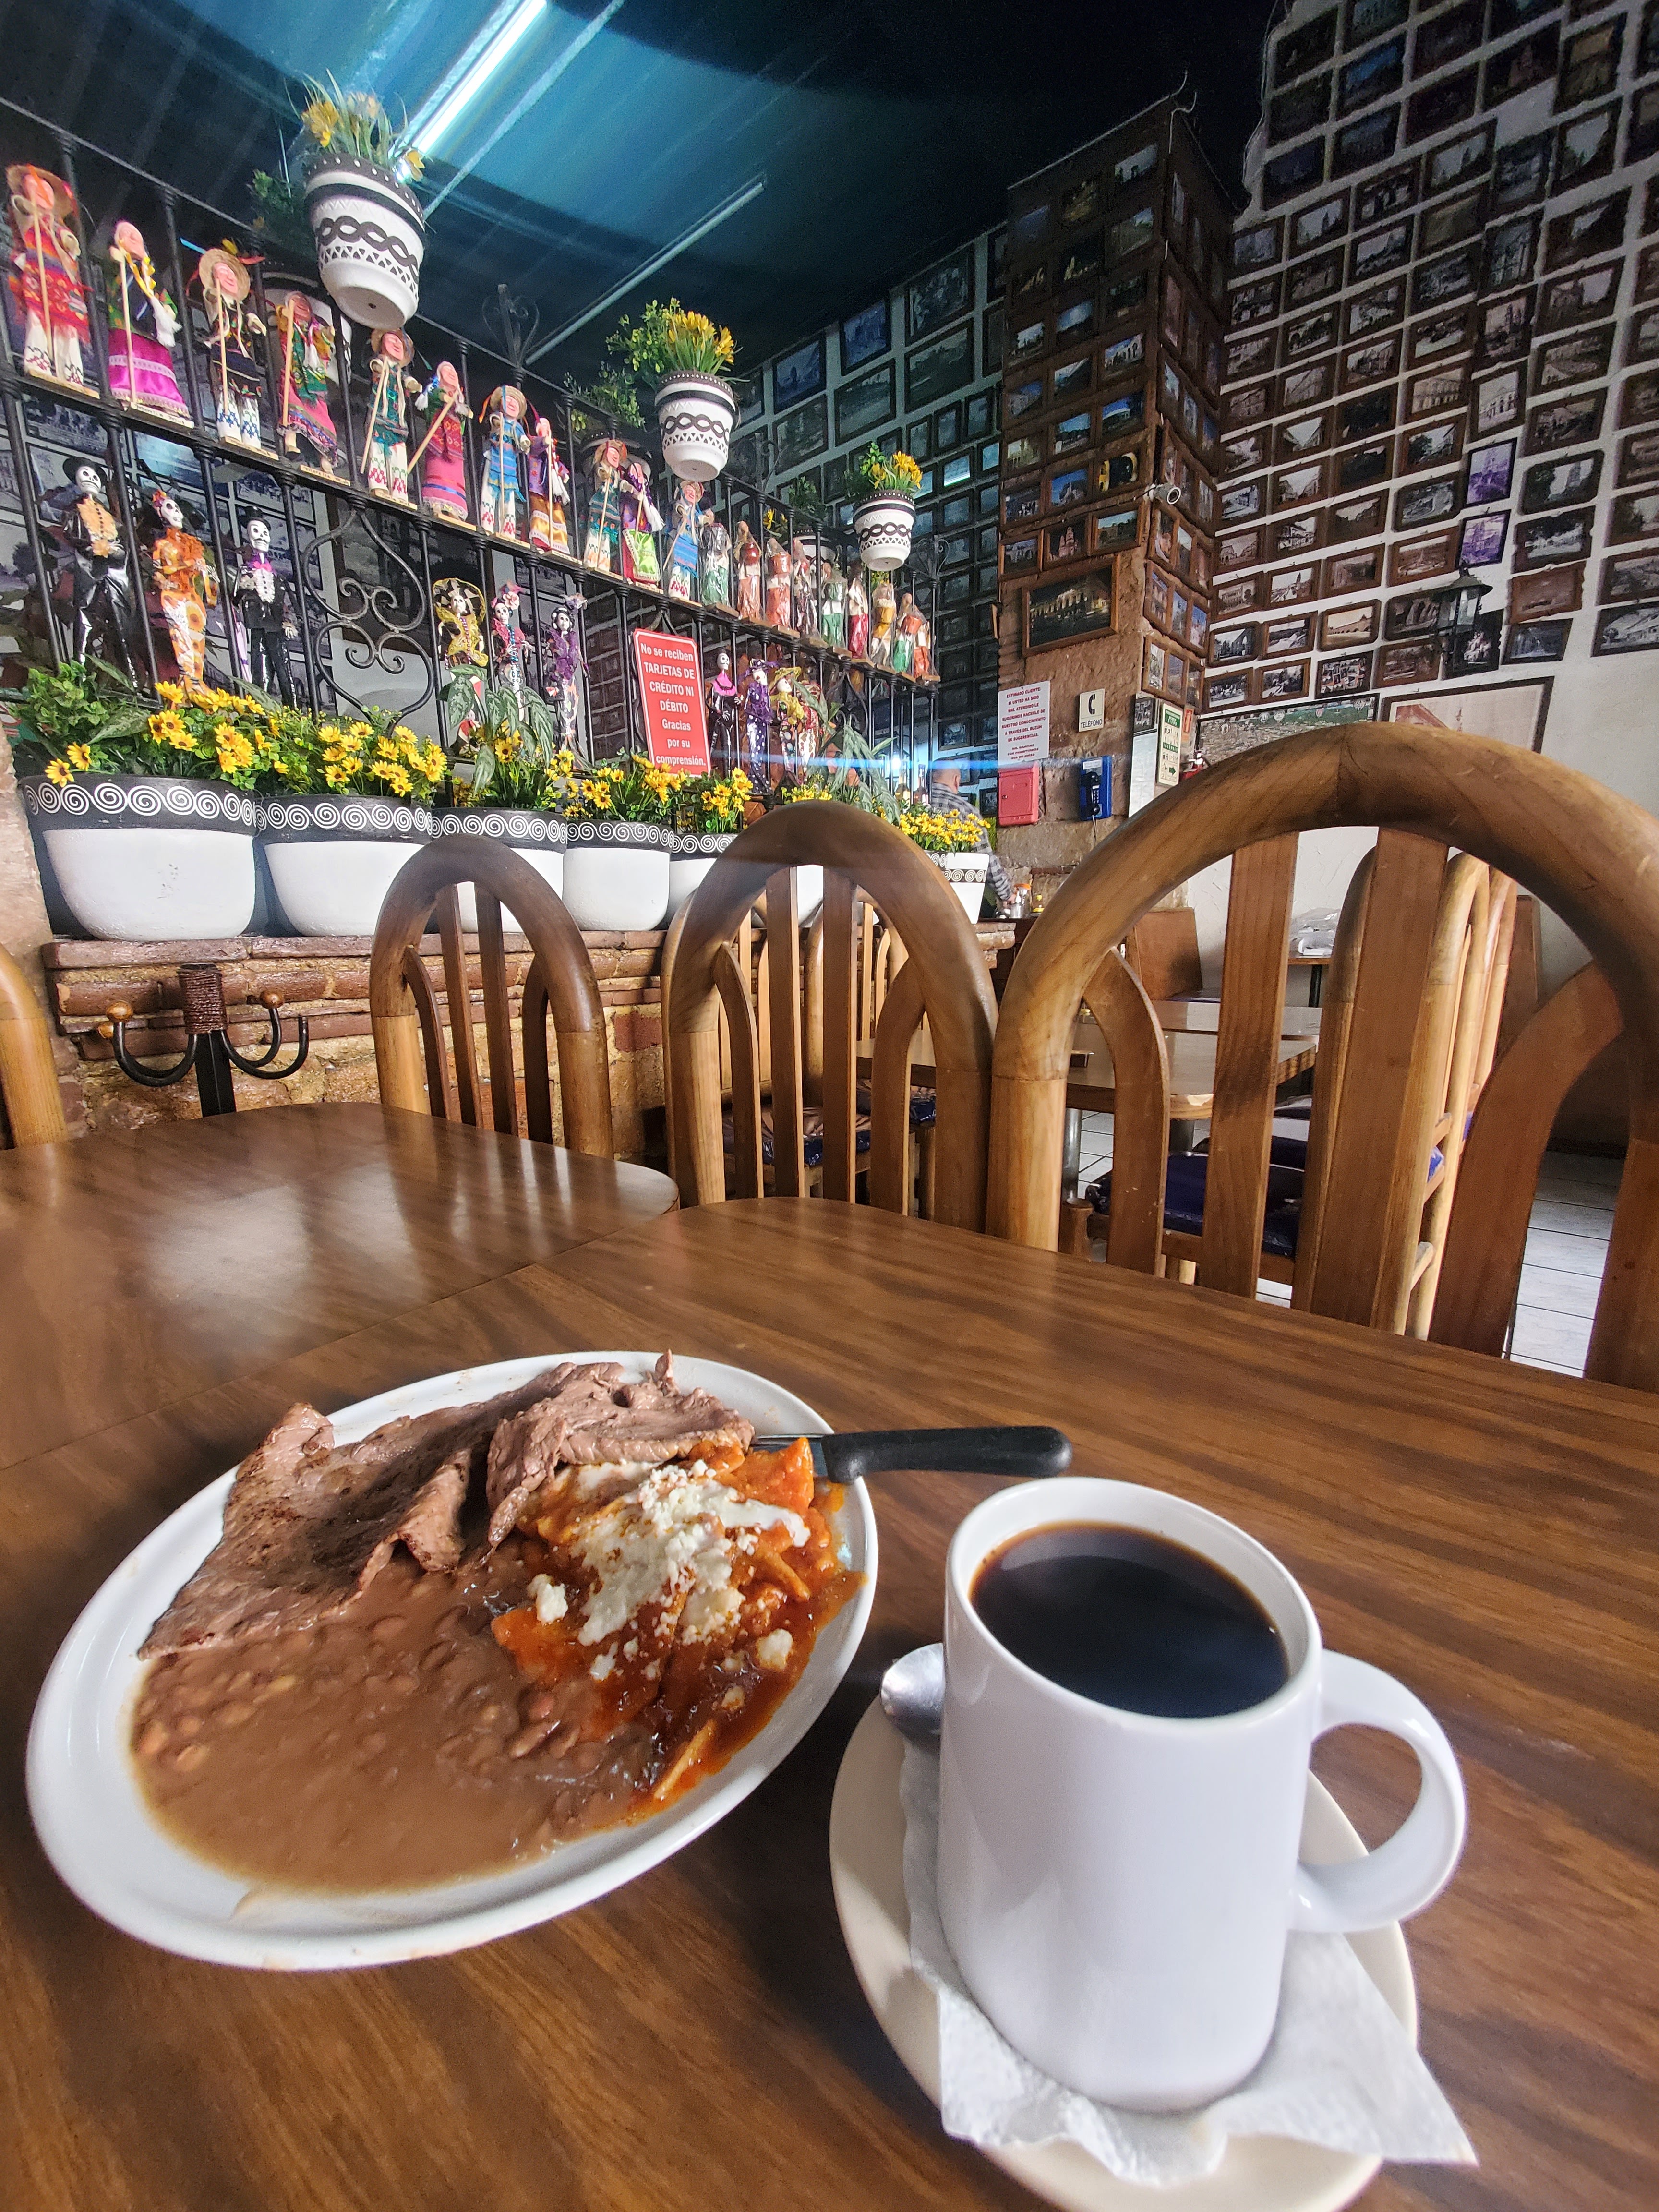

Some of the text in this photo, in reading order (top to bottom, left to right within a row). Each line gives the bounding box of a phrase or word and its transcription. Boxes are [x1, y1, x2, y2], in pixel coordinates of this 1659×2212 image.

[640, 643, 694, 662] No se reciben
[644, 661, 695, 679] TARJETAS DE
[649, 680, 694, 697] CRÉDITO NI
[660, 698, 689, 713] DÉBITO
[662, 718, 691, 731] Gracias
[1019, 717, 1046, 725] CONOCIMIENTO
[667, 739, 690, 749] por su
[656, 755, 706, 767] comprensión.
